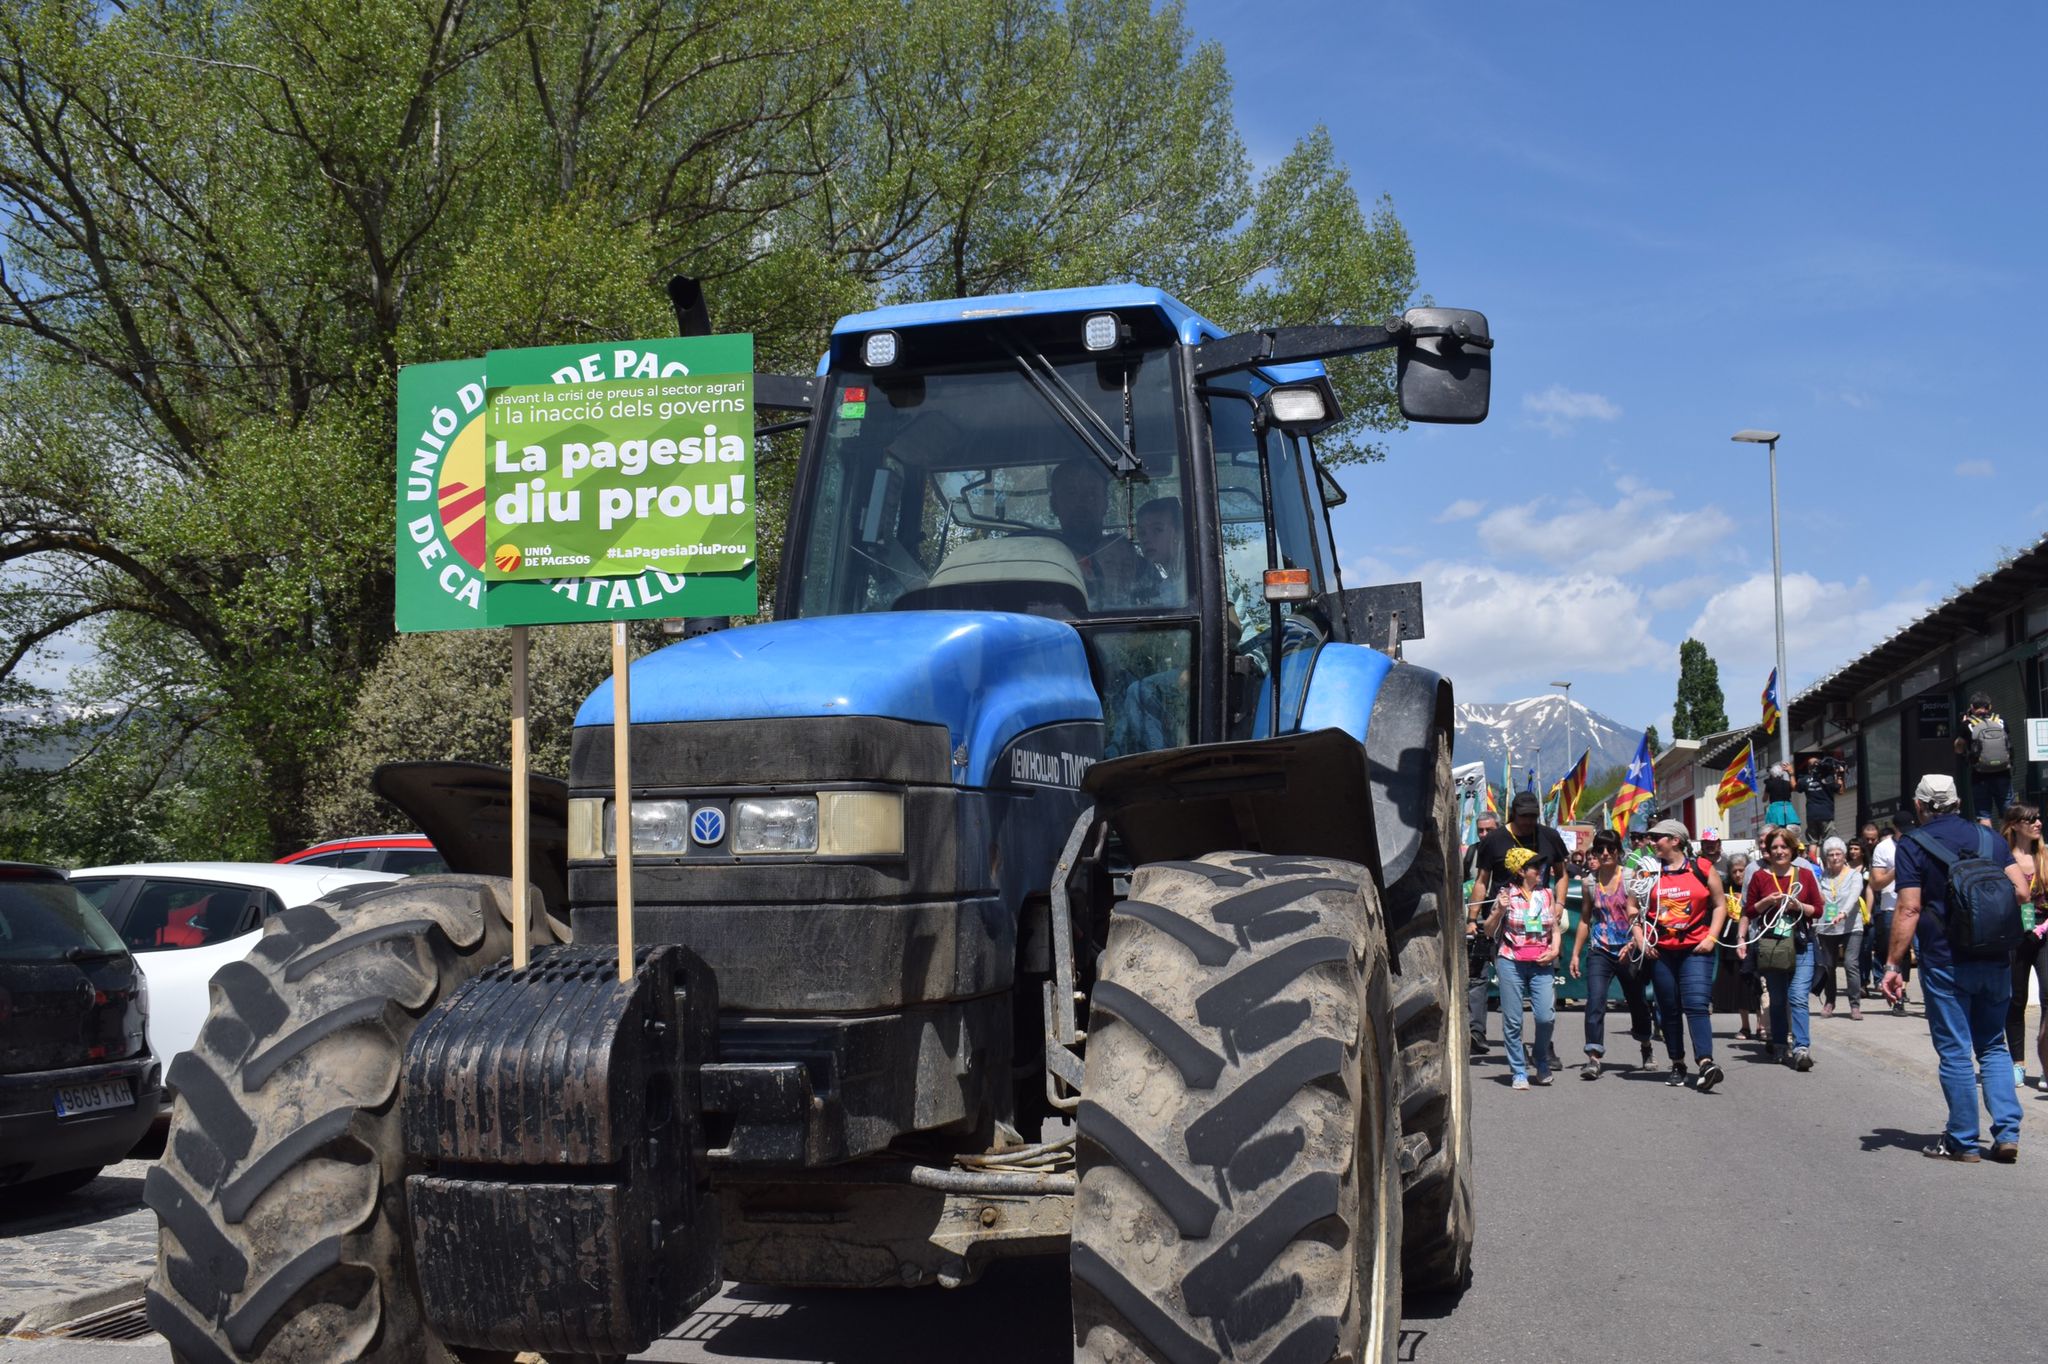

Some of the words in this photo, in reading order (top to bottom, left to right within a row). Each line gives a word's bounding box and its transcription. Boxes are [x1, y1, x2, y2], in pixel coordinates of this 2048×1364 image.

[495, 393, 540, 405] davant
[543, 391, 554, 402] la
[557, 388, 584, 402] crisi
[586, 388, 603, 400] de
[607, 387, 644, 401] preus
[647, 385, 658, 396] al
[662, 384, 703, 396] sector
[706, 380, 745, 395] agrari
[495, 407, 500, 425] i
[506, 407, 523, 424] la
[529, 402, 604, 422] inacció
[610, 399, 653, 418] dels
[659, 398, 745, 420] governs
[407, 405, 458, 501] UNIÓ
[456, 375, 487, 415] D
[495, 440, 547, 473] La
[562, 424, 745, 478] pagesia
[495, 478, 581, 525] diu
[599, 474, 746, 530] prou!
[408, 513, 447, 570] DE
[524, 545, 552, 557] UNIÓ
[607, 543, 746, 560] #LaPagesiaDiuProu
[525, 557, 539, 567] DE
[541, 555, 591, 566] PAGESOS
[63, 1086, 101, 1110] 9609
